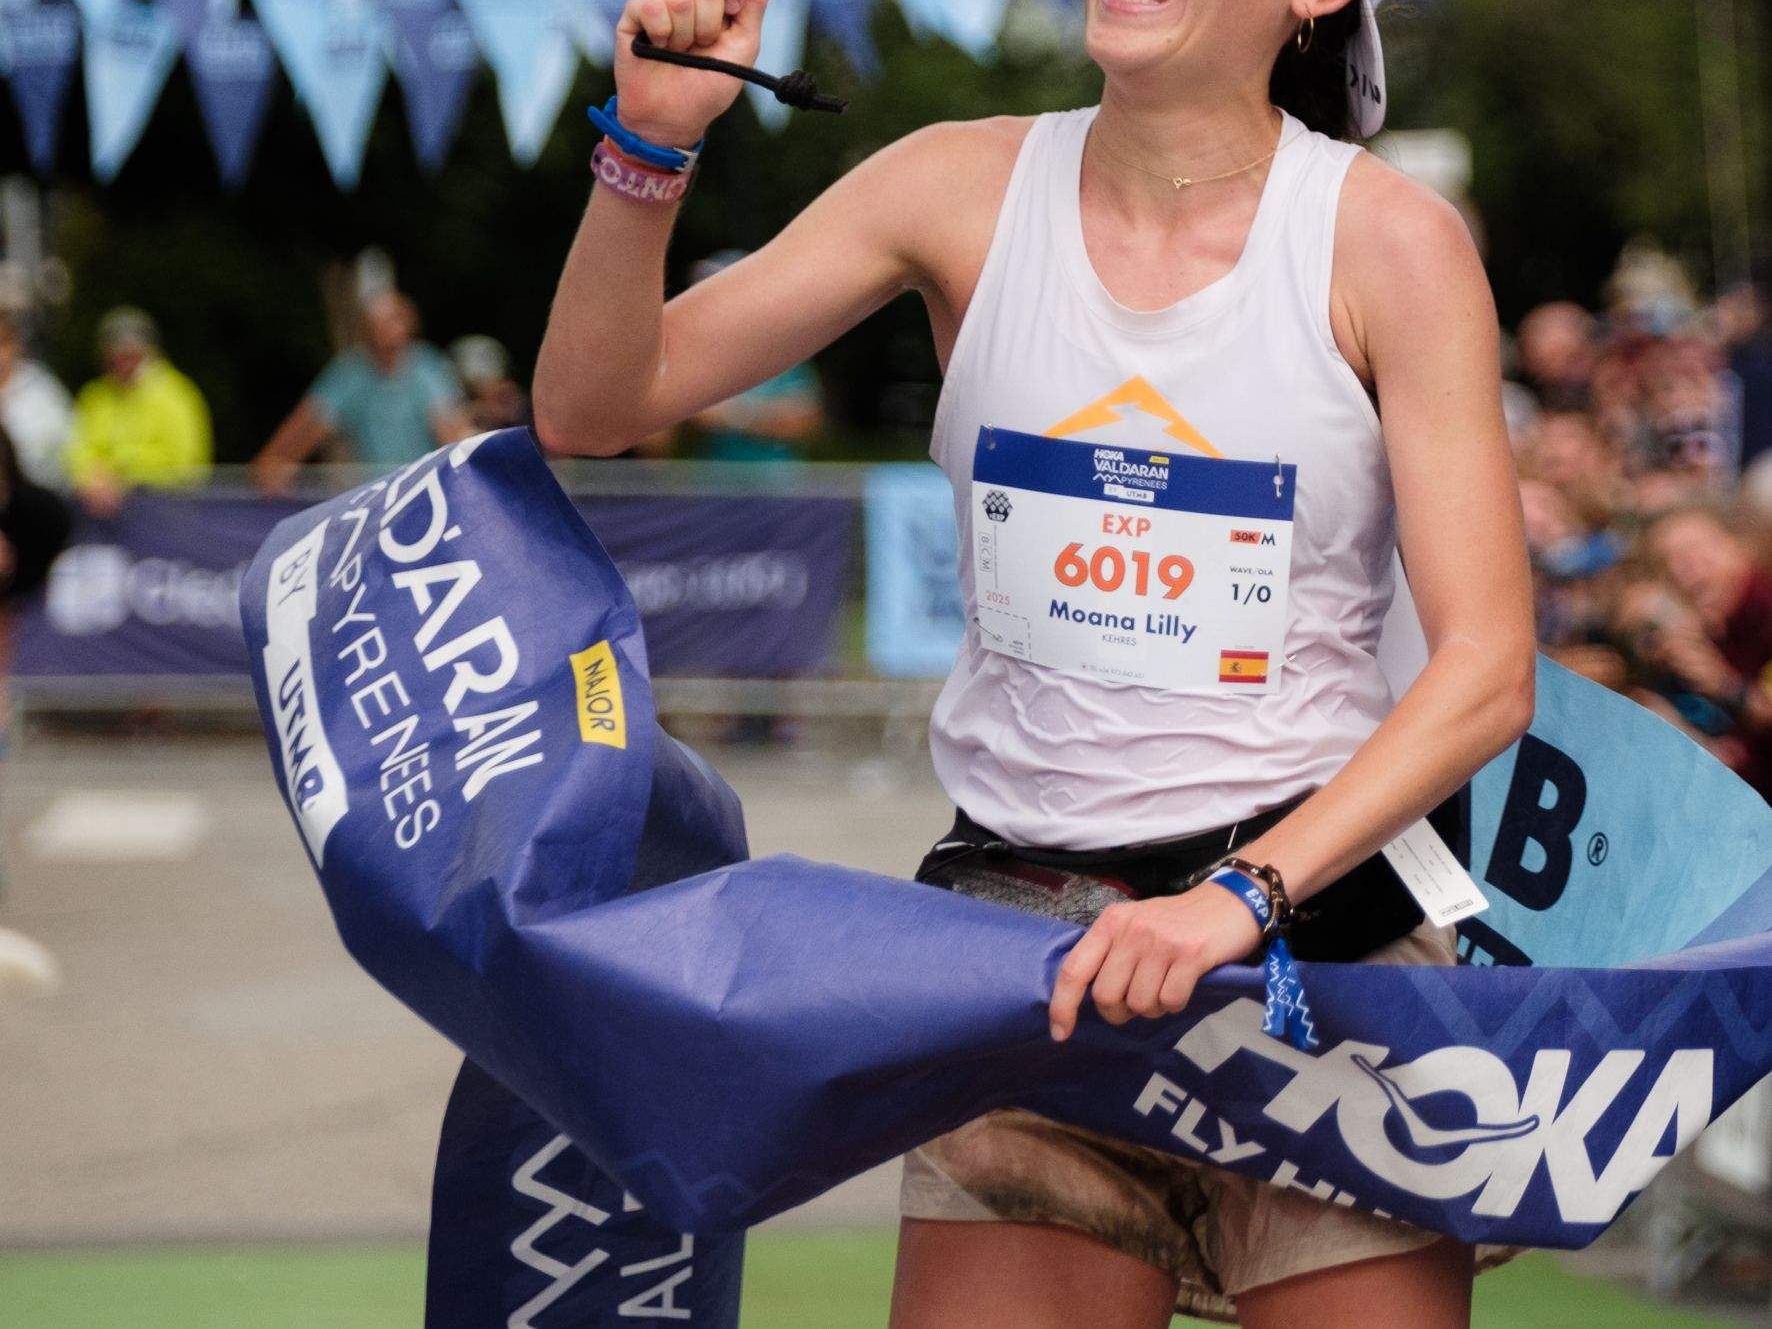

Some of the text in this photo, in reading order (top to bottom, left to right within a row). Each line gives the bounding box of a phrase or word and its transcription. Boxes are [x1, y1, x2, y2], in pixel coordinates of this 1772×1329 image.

[1094, 448, 1124, 461] HOKA
[1121, 475, 1168, 490] PYRENEES
[1102, 513, 1152, 537] EXP
[277, 547, 312, 607] BY
[1054, 542, 1195, 600] 6019
[985, 591, 1010, 606] 2025
[1048, 599, 1198, 644] Moana Lilly
[329, 553, 441, 849] PYRENEES
[583, 658, 615, 731] MAJOR
[1246, 888, 1269, 918] EXP
[1132, 1072, 1266, 1163] FLY
